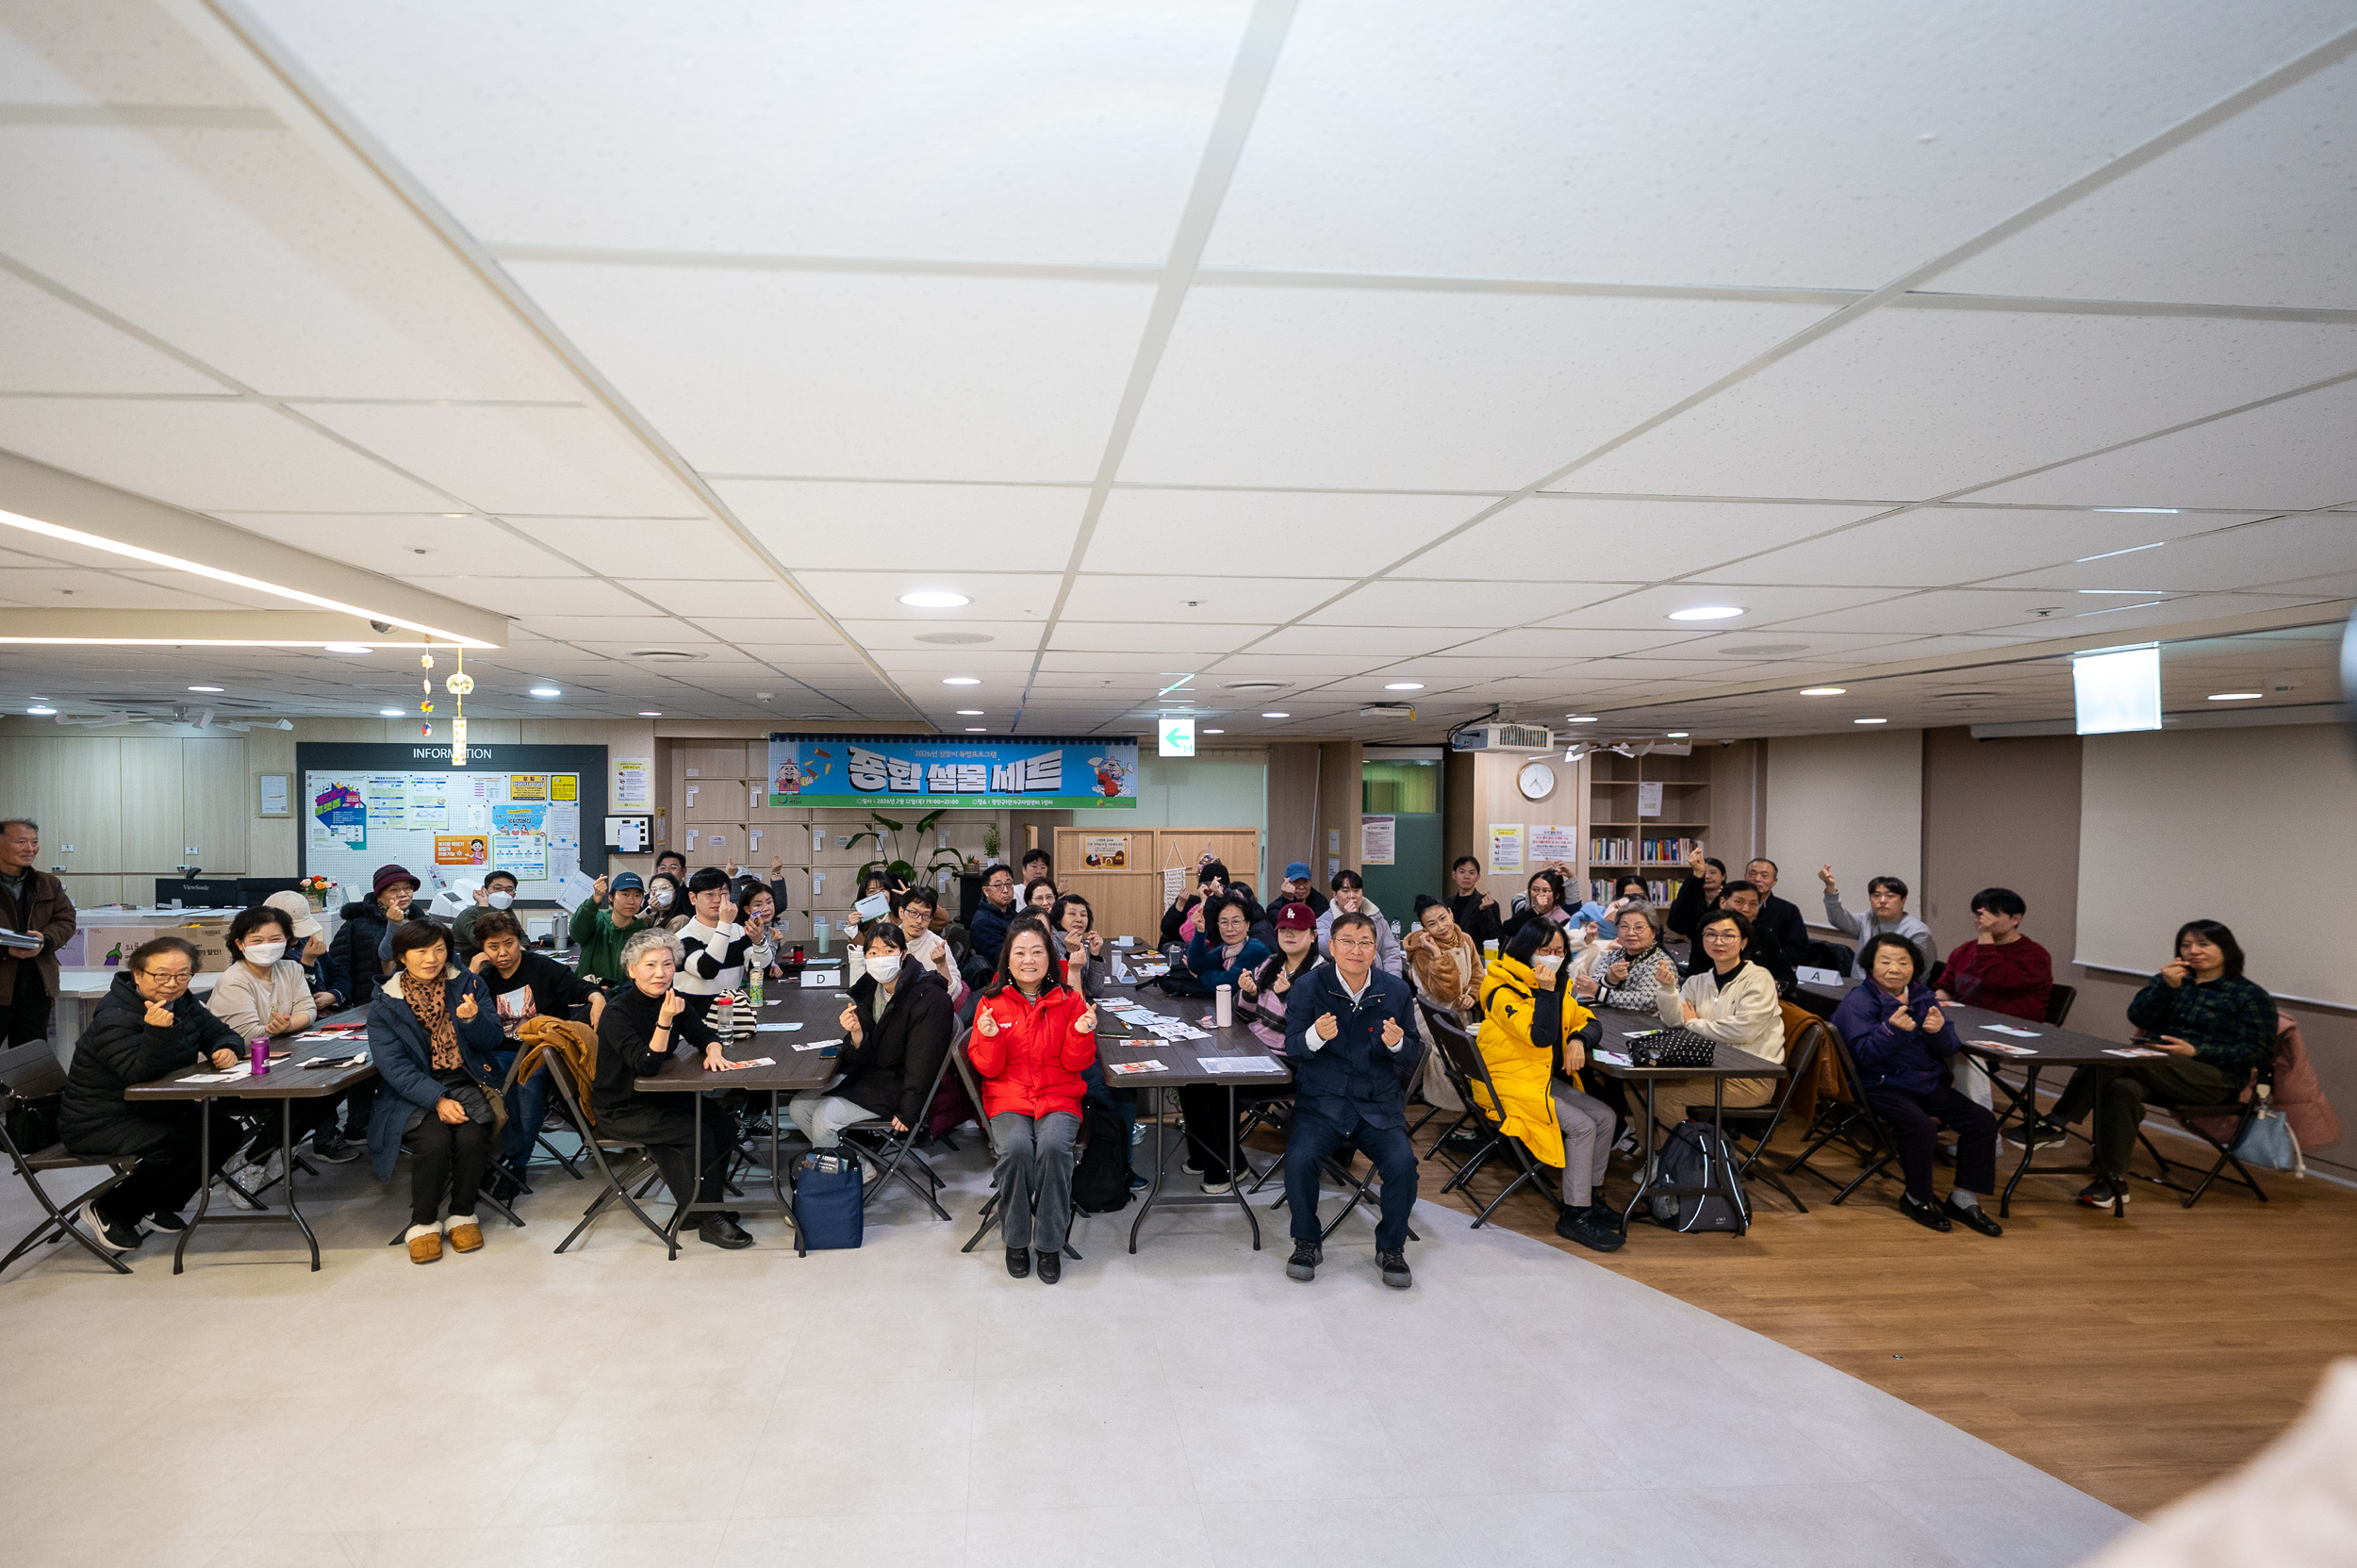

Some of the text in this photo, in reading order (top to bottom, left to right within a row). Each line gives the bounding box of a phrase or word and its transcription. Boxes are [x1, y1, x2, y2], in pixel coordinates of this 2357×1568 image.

[413, 748, 492, 759] INFORMTION
[915, 750, 938, 758] 2026년
[959, 751, 997, 759] 특별프로그램
[849, 746, 922, 792] 종합
[991, 750, 1063, 793] 세트
[816, 974, 826, 984] D
[1811, 971, 1821, 982] A
